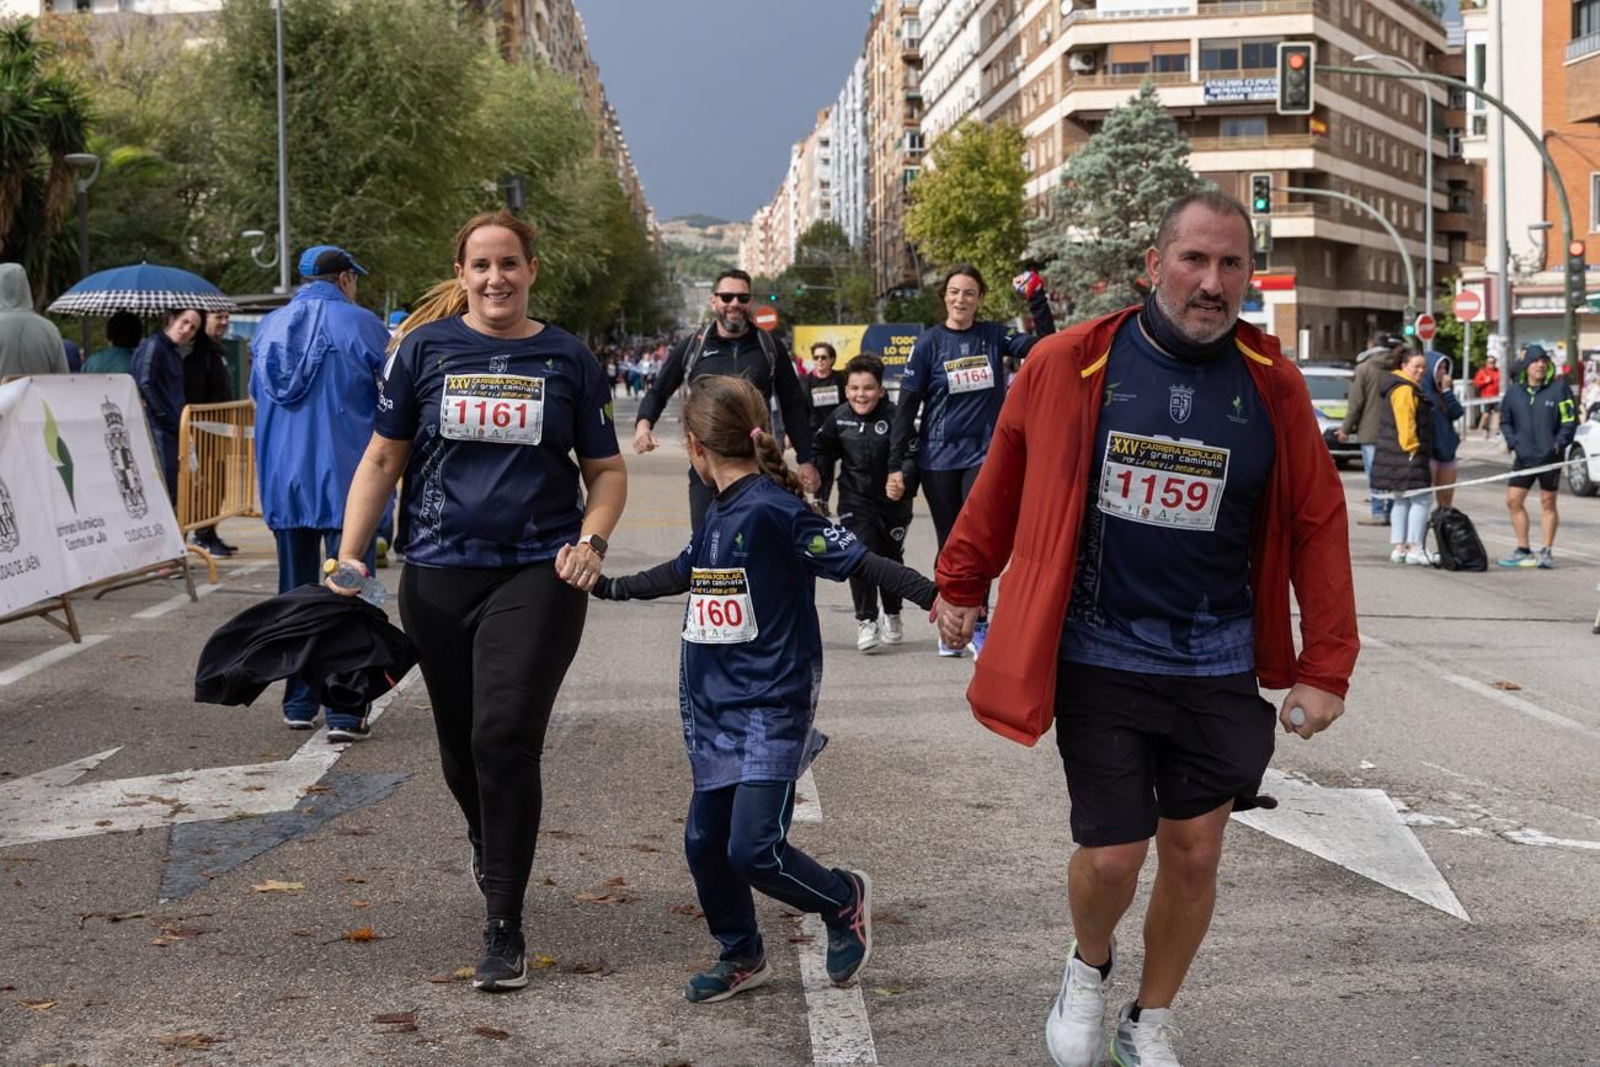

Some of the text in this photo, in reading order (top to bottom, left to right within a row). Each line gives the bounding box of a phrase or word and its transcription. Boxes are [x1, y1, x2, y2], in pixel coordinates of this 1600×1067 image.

[448, 377, 471, 390] XXV
[472, 378, 505, 386] CARRERA
[954, 369, 988, 385] 1164
[503, 384, 540, 394] caminata
[454, 399, 528, 429] 1161
[1111, 437, 1223, 462] XXV CARRERA POPULAR
[1150, 451, 1175, 461] gran
[1178, 455, 1222, 469] caminata
[1116, 470, 1210, 513] 1159
